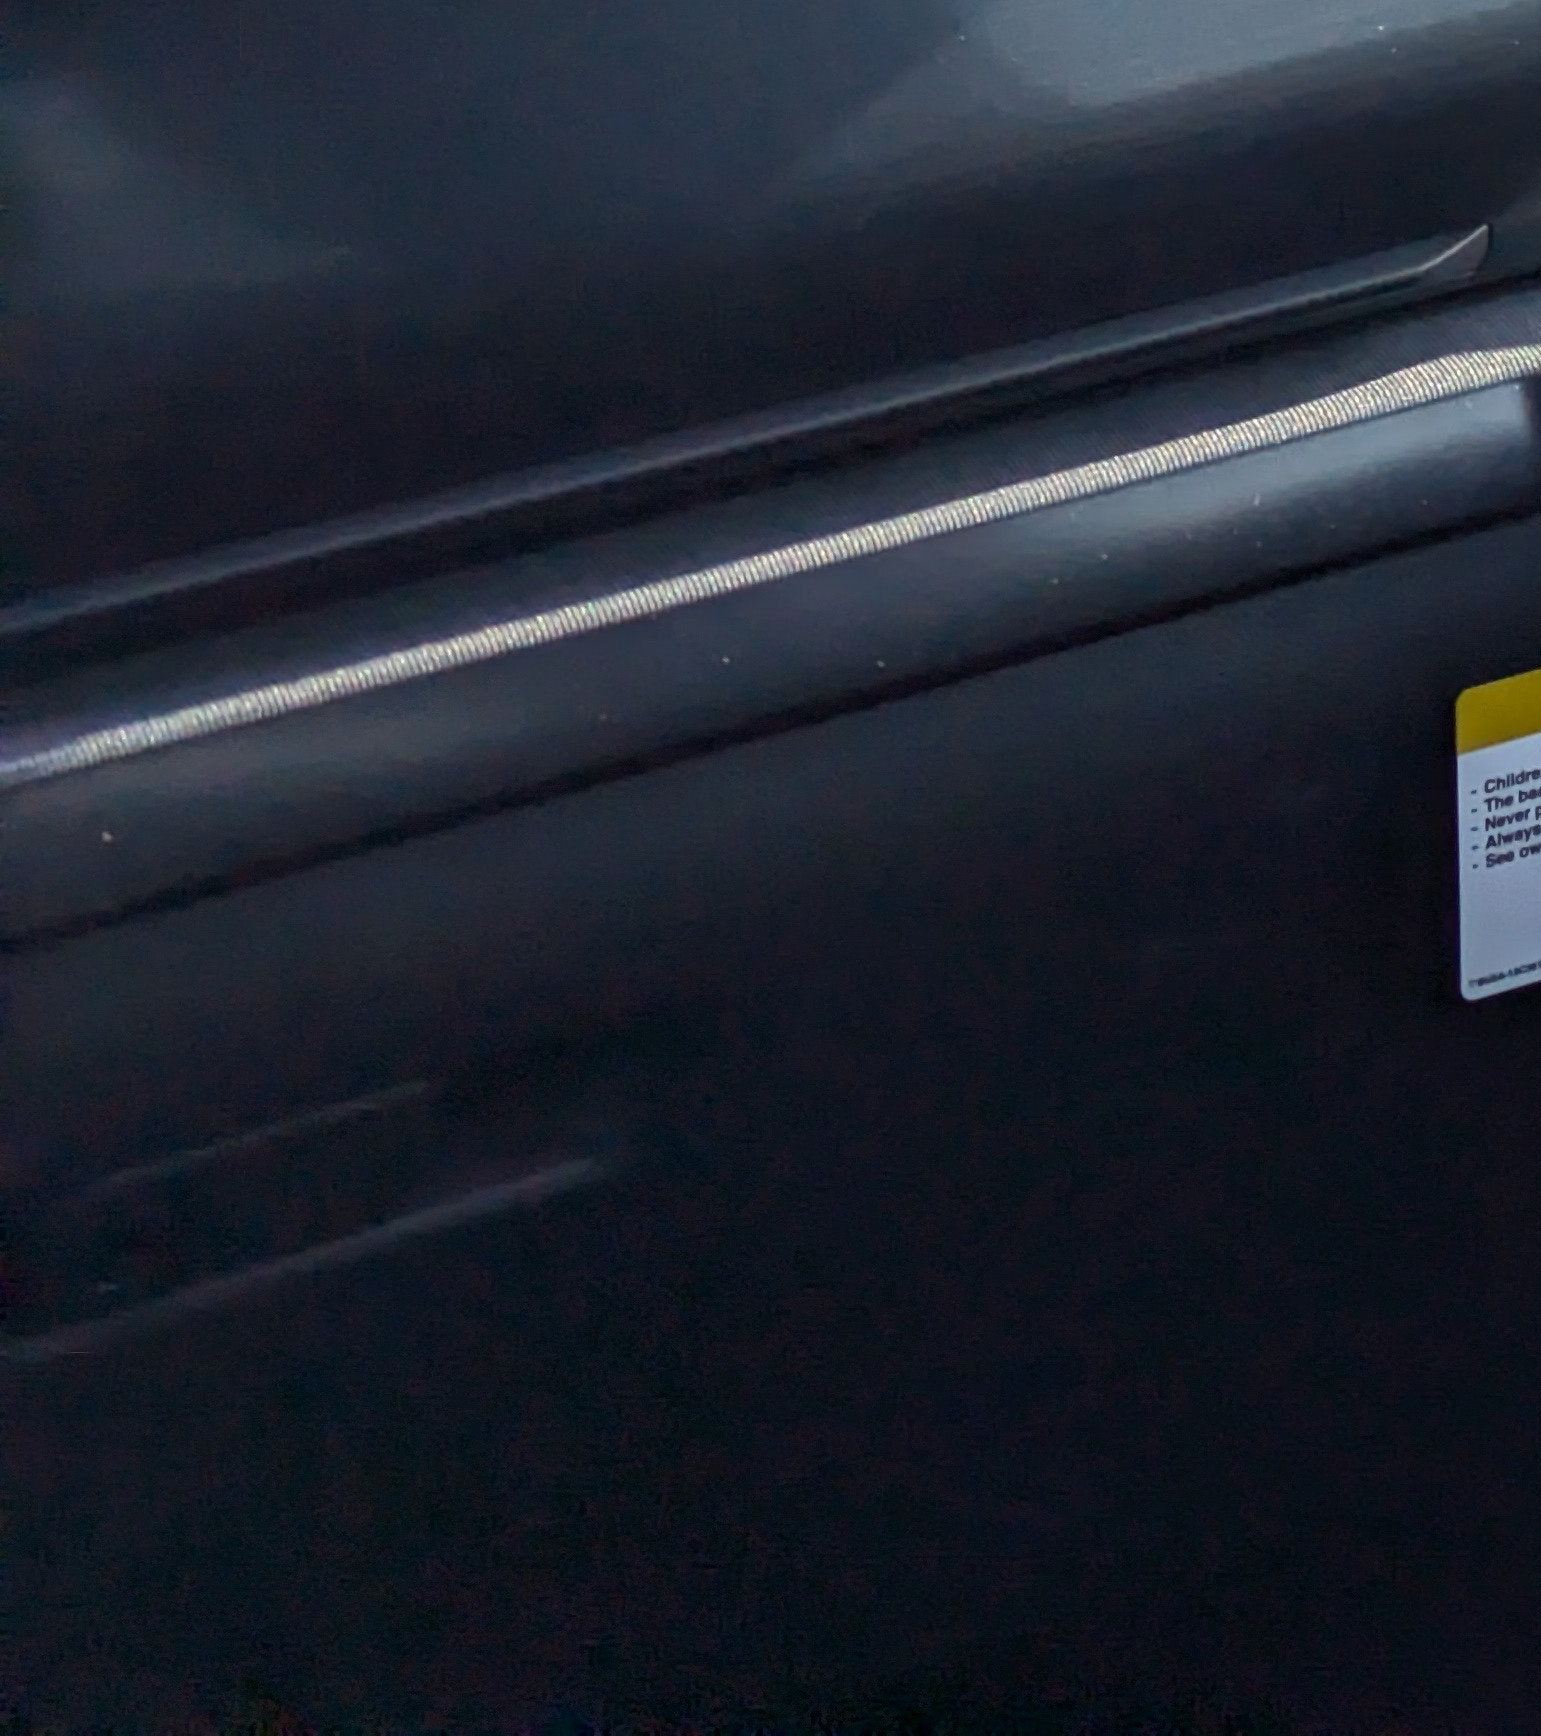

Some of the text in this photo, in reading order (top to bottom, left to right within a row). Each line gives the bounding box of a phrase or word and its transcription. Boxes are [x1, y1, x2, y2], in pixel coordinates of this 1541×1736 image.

[1484, 795, 1514, 812] The
[1485, 809, 1531, 831] Never
[1485, 825, 1541, 849] Always
[1486, 851, 1515, 868] See
